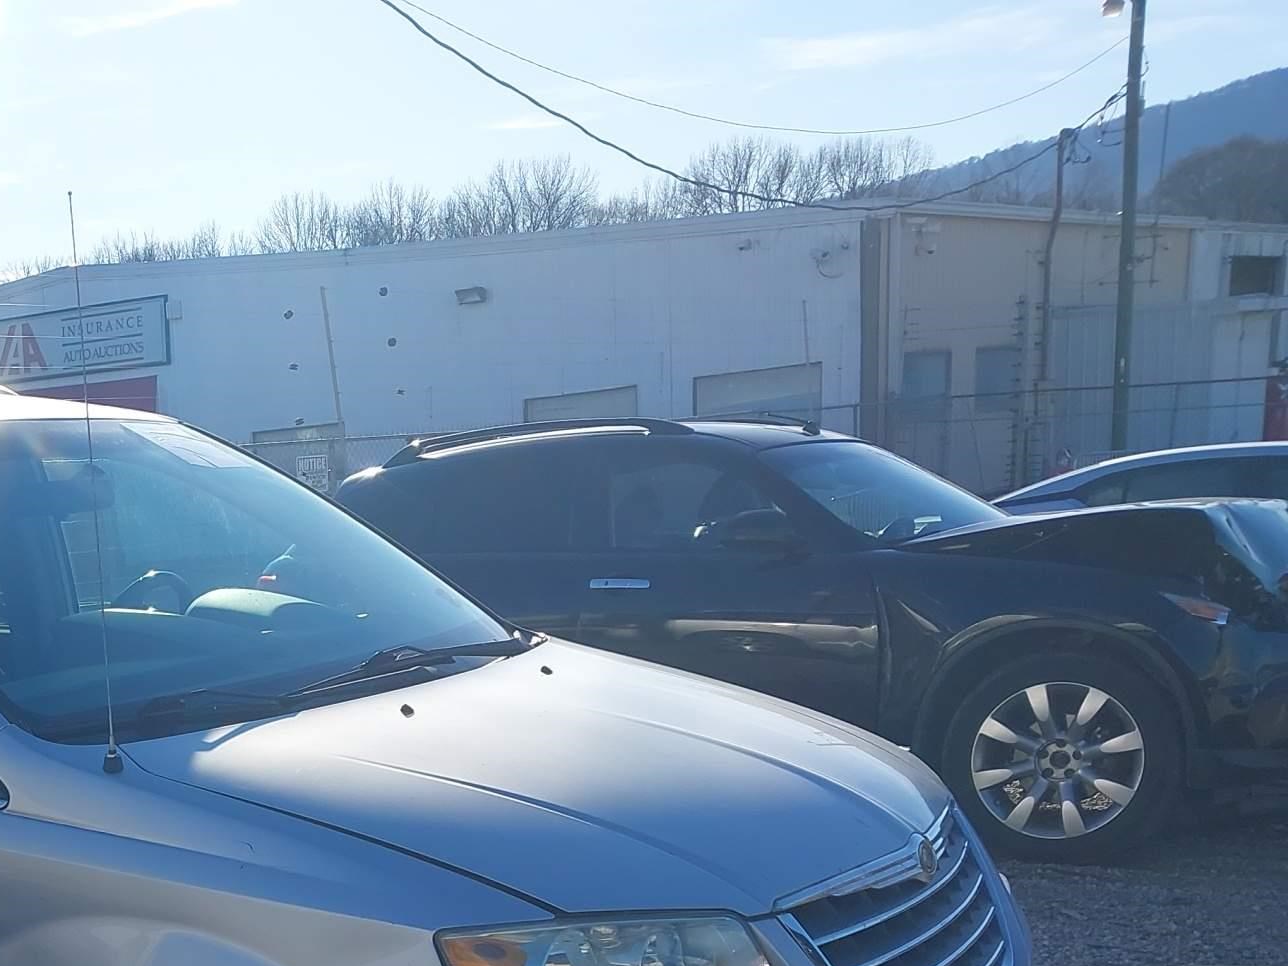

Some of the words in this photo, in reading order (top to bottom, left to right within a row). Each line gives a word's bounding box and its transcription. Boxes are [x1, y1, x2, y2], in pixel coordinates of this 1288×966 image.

[61, 315, 144, 337] INSURANCE
[64, 348, 91, 364] AUTO
[92, 341, 145, 359] AUCTIONS
[297, 457, 327, 472] NOTICE
